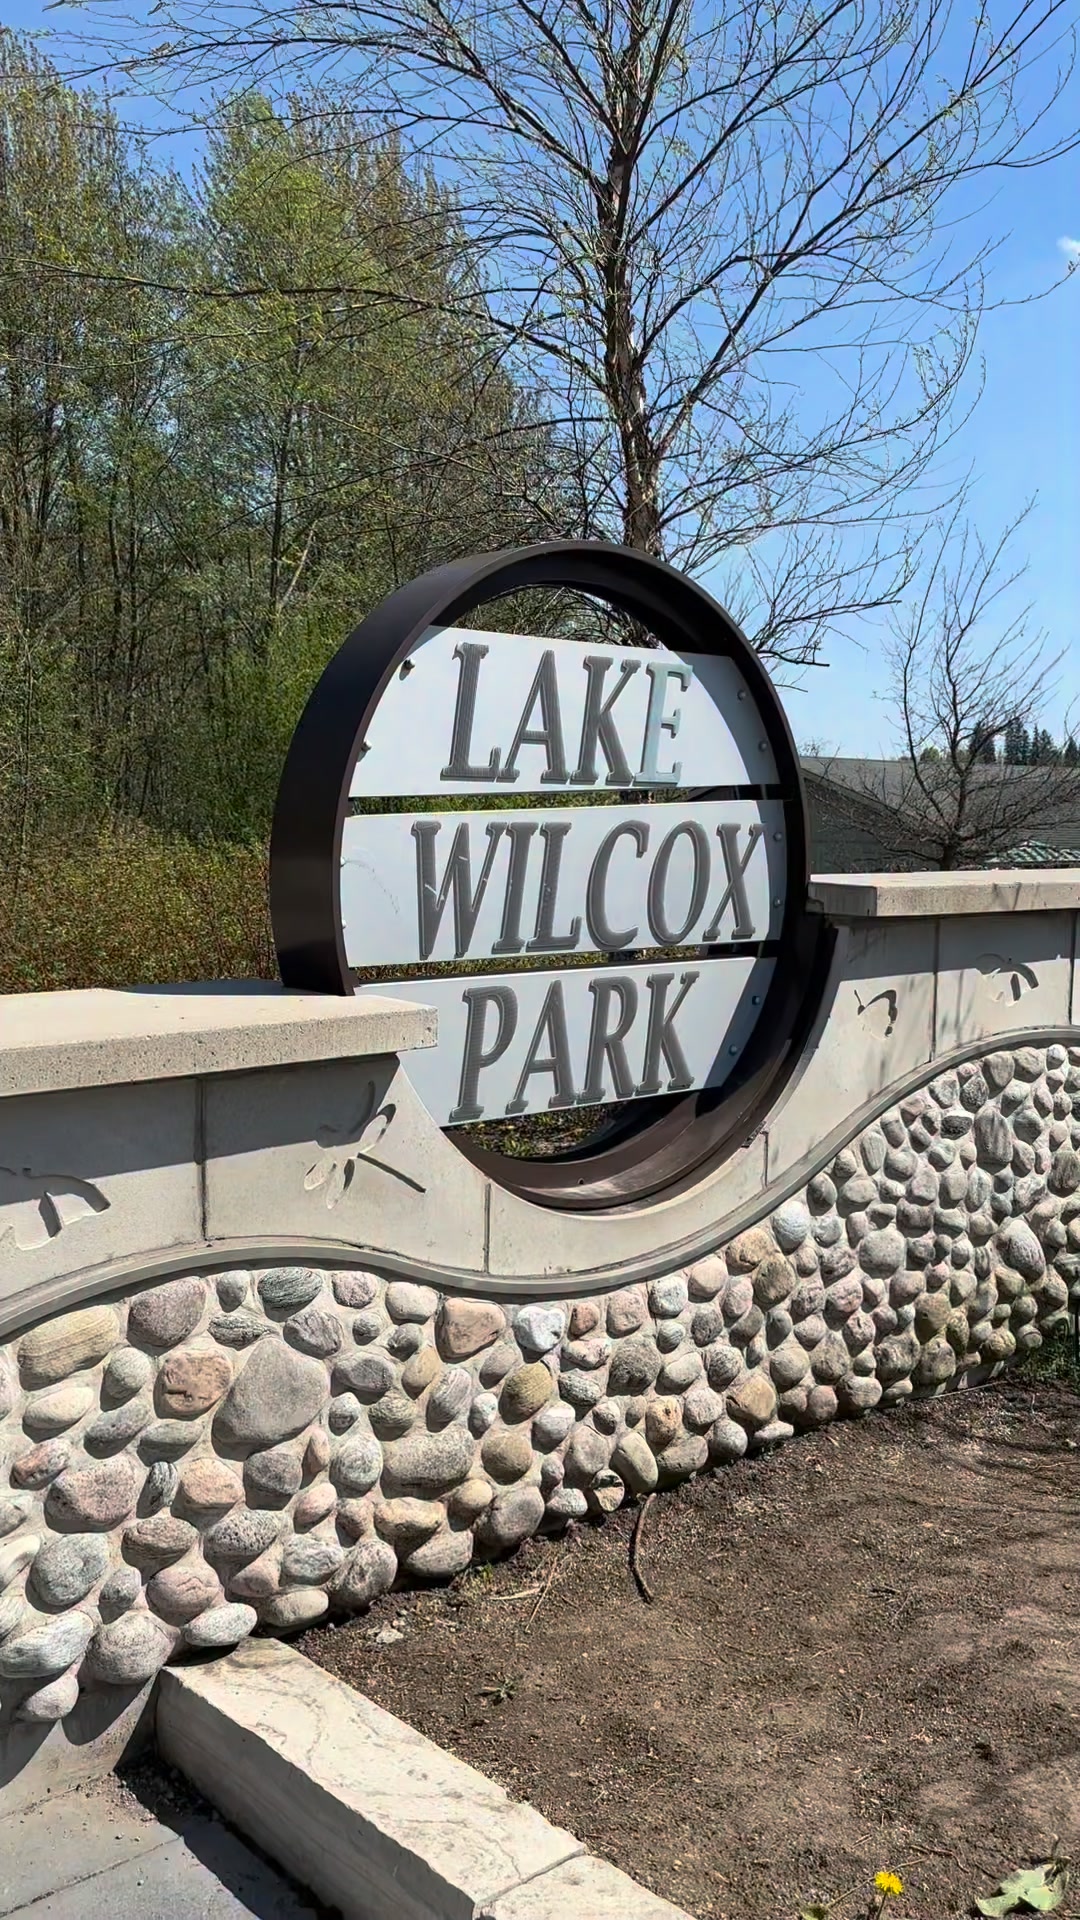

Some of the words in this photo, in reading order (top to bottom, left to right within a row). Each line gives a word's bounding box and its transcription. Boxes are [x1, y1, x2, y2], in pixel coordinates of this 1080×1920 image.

[440, 641, 693, 786] LAKE
[409, 819, 766, 961] WILCOX
[448, 971, 700, 1122] PARK
